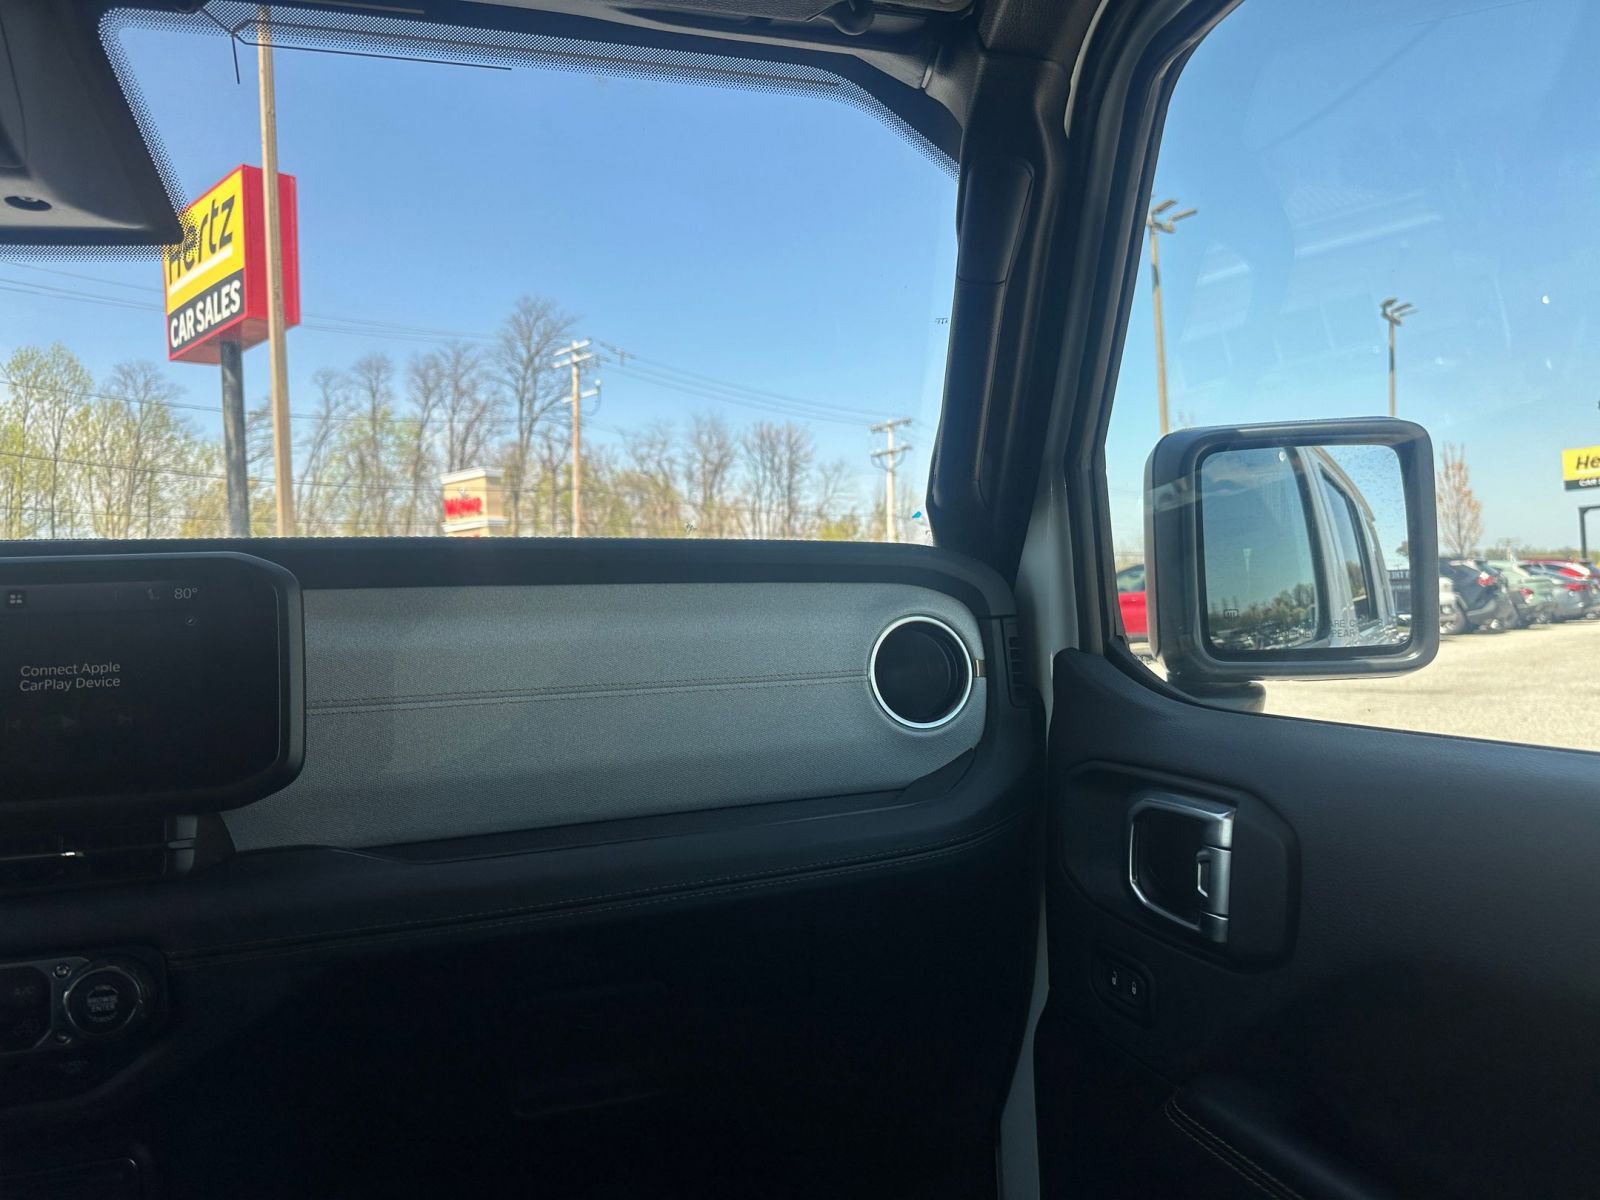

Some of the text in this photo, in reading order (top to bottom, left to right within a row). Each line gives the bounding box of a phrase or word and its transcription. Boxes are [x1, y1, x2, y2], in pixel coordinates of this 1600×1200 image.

[169, 195, 235, 286] Hertz
[170, 280, 241, 348] CAR SALES
[19, 676, 121, 692] CarPlay Device
[20, 661, 121, 677] Connect Apple
